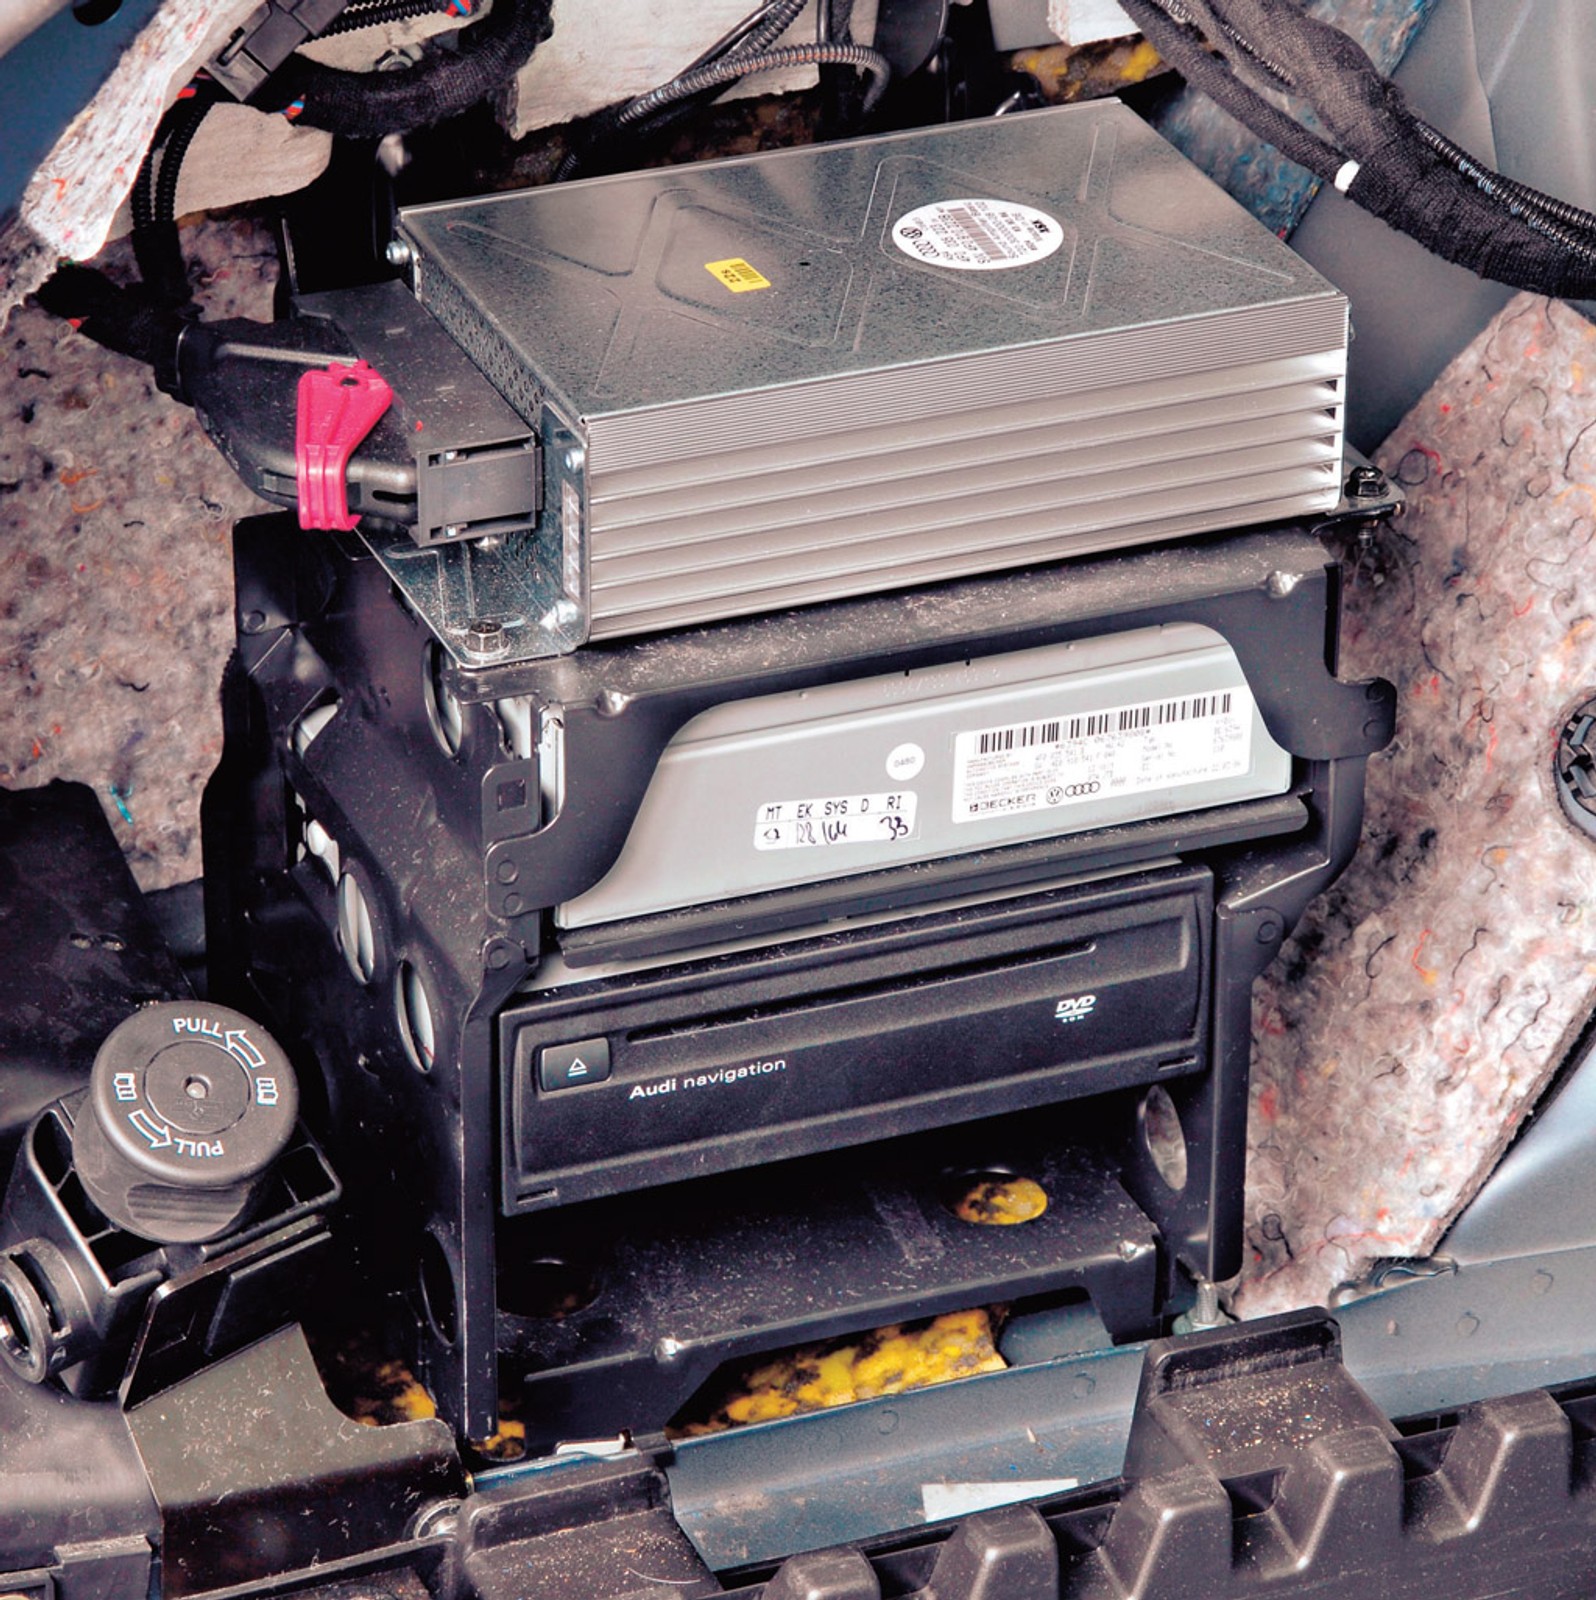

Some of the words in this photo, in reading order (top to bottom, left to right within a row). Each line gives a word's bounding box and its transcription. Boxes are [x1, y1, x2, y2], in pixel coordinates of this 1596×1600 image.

[765, 805, 783, 820] MT
[797, 803, 814, 818] EK
[824, 800, 848, 816] SYS
[861, 798, 869, 812] D
[1056, 994, 1097, 1012] DVD
[173, 1017, 224, 1038] PULL
[629, 1078, 677, 1100] Audi
[683, 1059, 786, 1089] navigation
[173, 1137, 224, 1157] PULL
